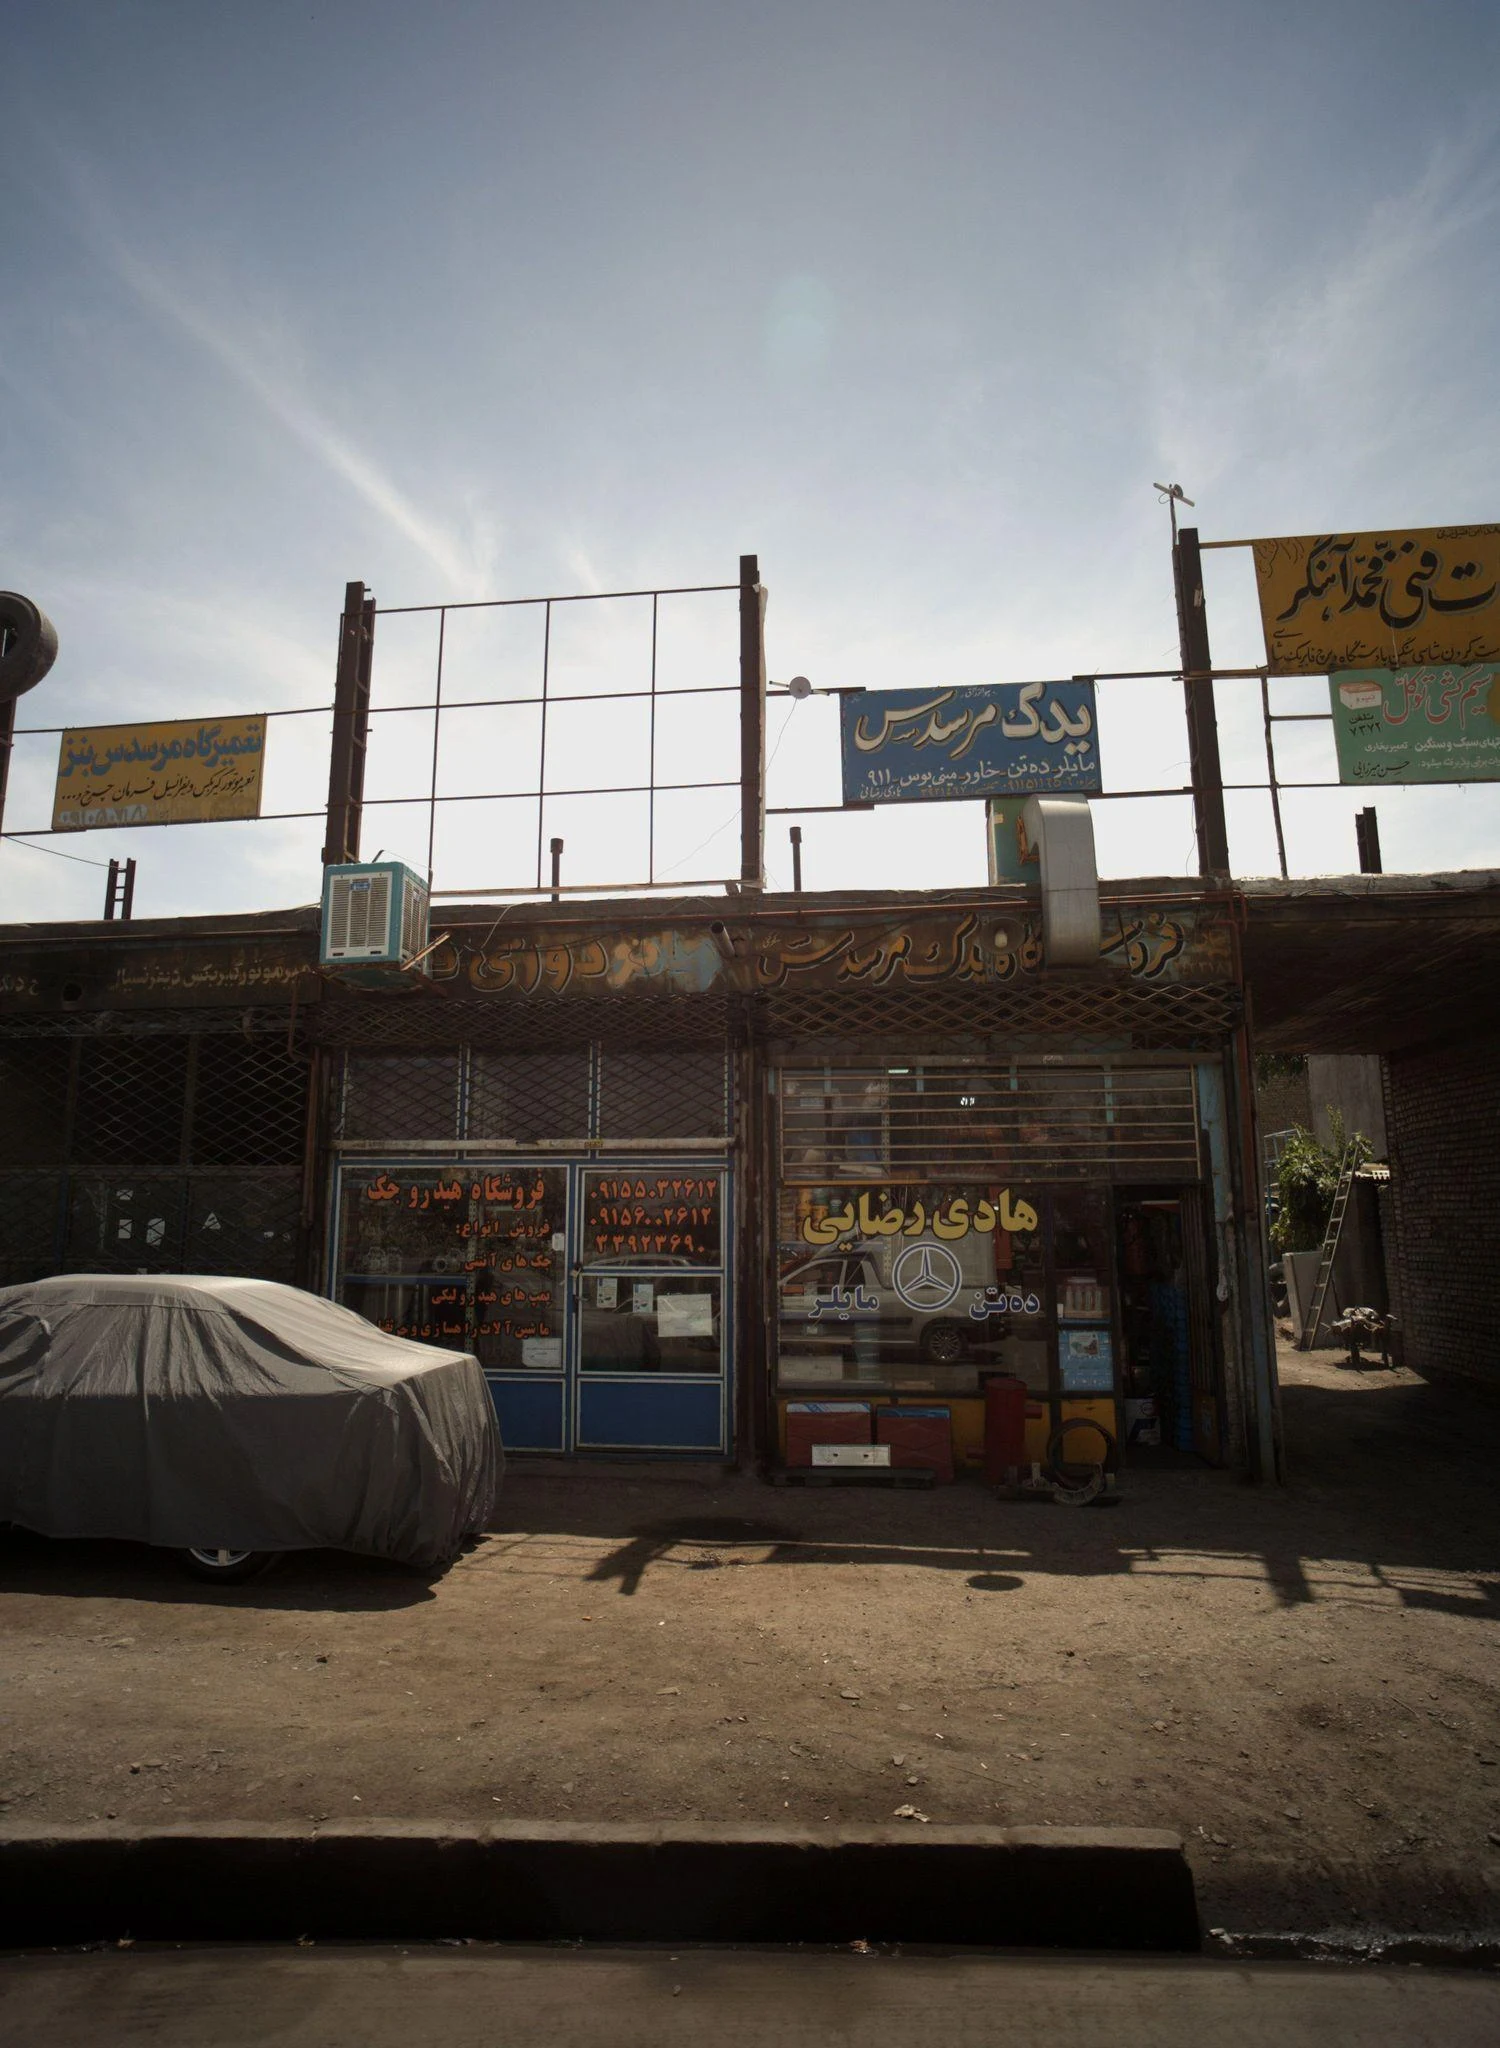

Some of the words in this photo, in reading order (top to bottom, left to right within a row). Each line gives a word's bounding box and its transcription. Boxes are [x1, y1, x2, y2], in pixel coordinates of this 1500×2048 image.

[1276, 535, 1355, 622] آهنگر
[854, 689, 999, 760] مرسدس
[1001, 682, 1092, 756] یدک
[58, 736, 95, 777] بنز
[92, 737, 183, 776] مرسدس
[184, 723, 262, 767] تعمیرگاه
[868, 768, 891, 787] ۹۱۱
[367, 1173, 401, 1204] جک
[471, 1171, 545, 1210] فروشگاه
[802, 1190, 927, 1252] رضایی
[931, 1187, 1039, 1241] هادی
[808, 1285, 880, 1320] مایلر
